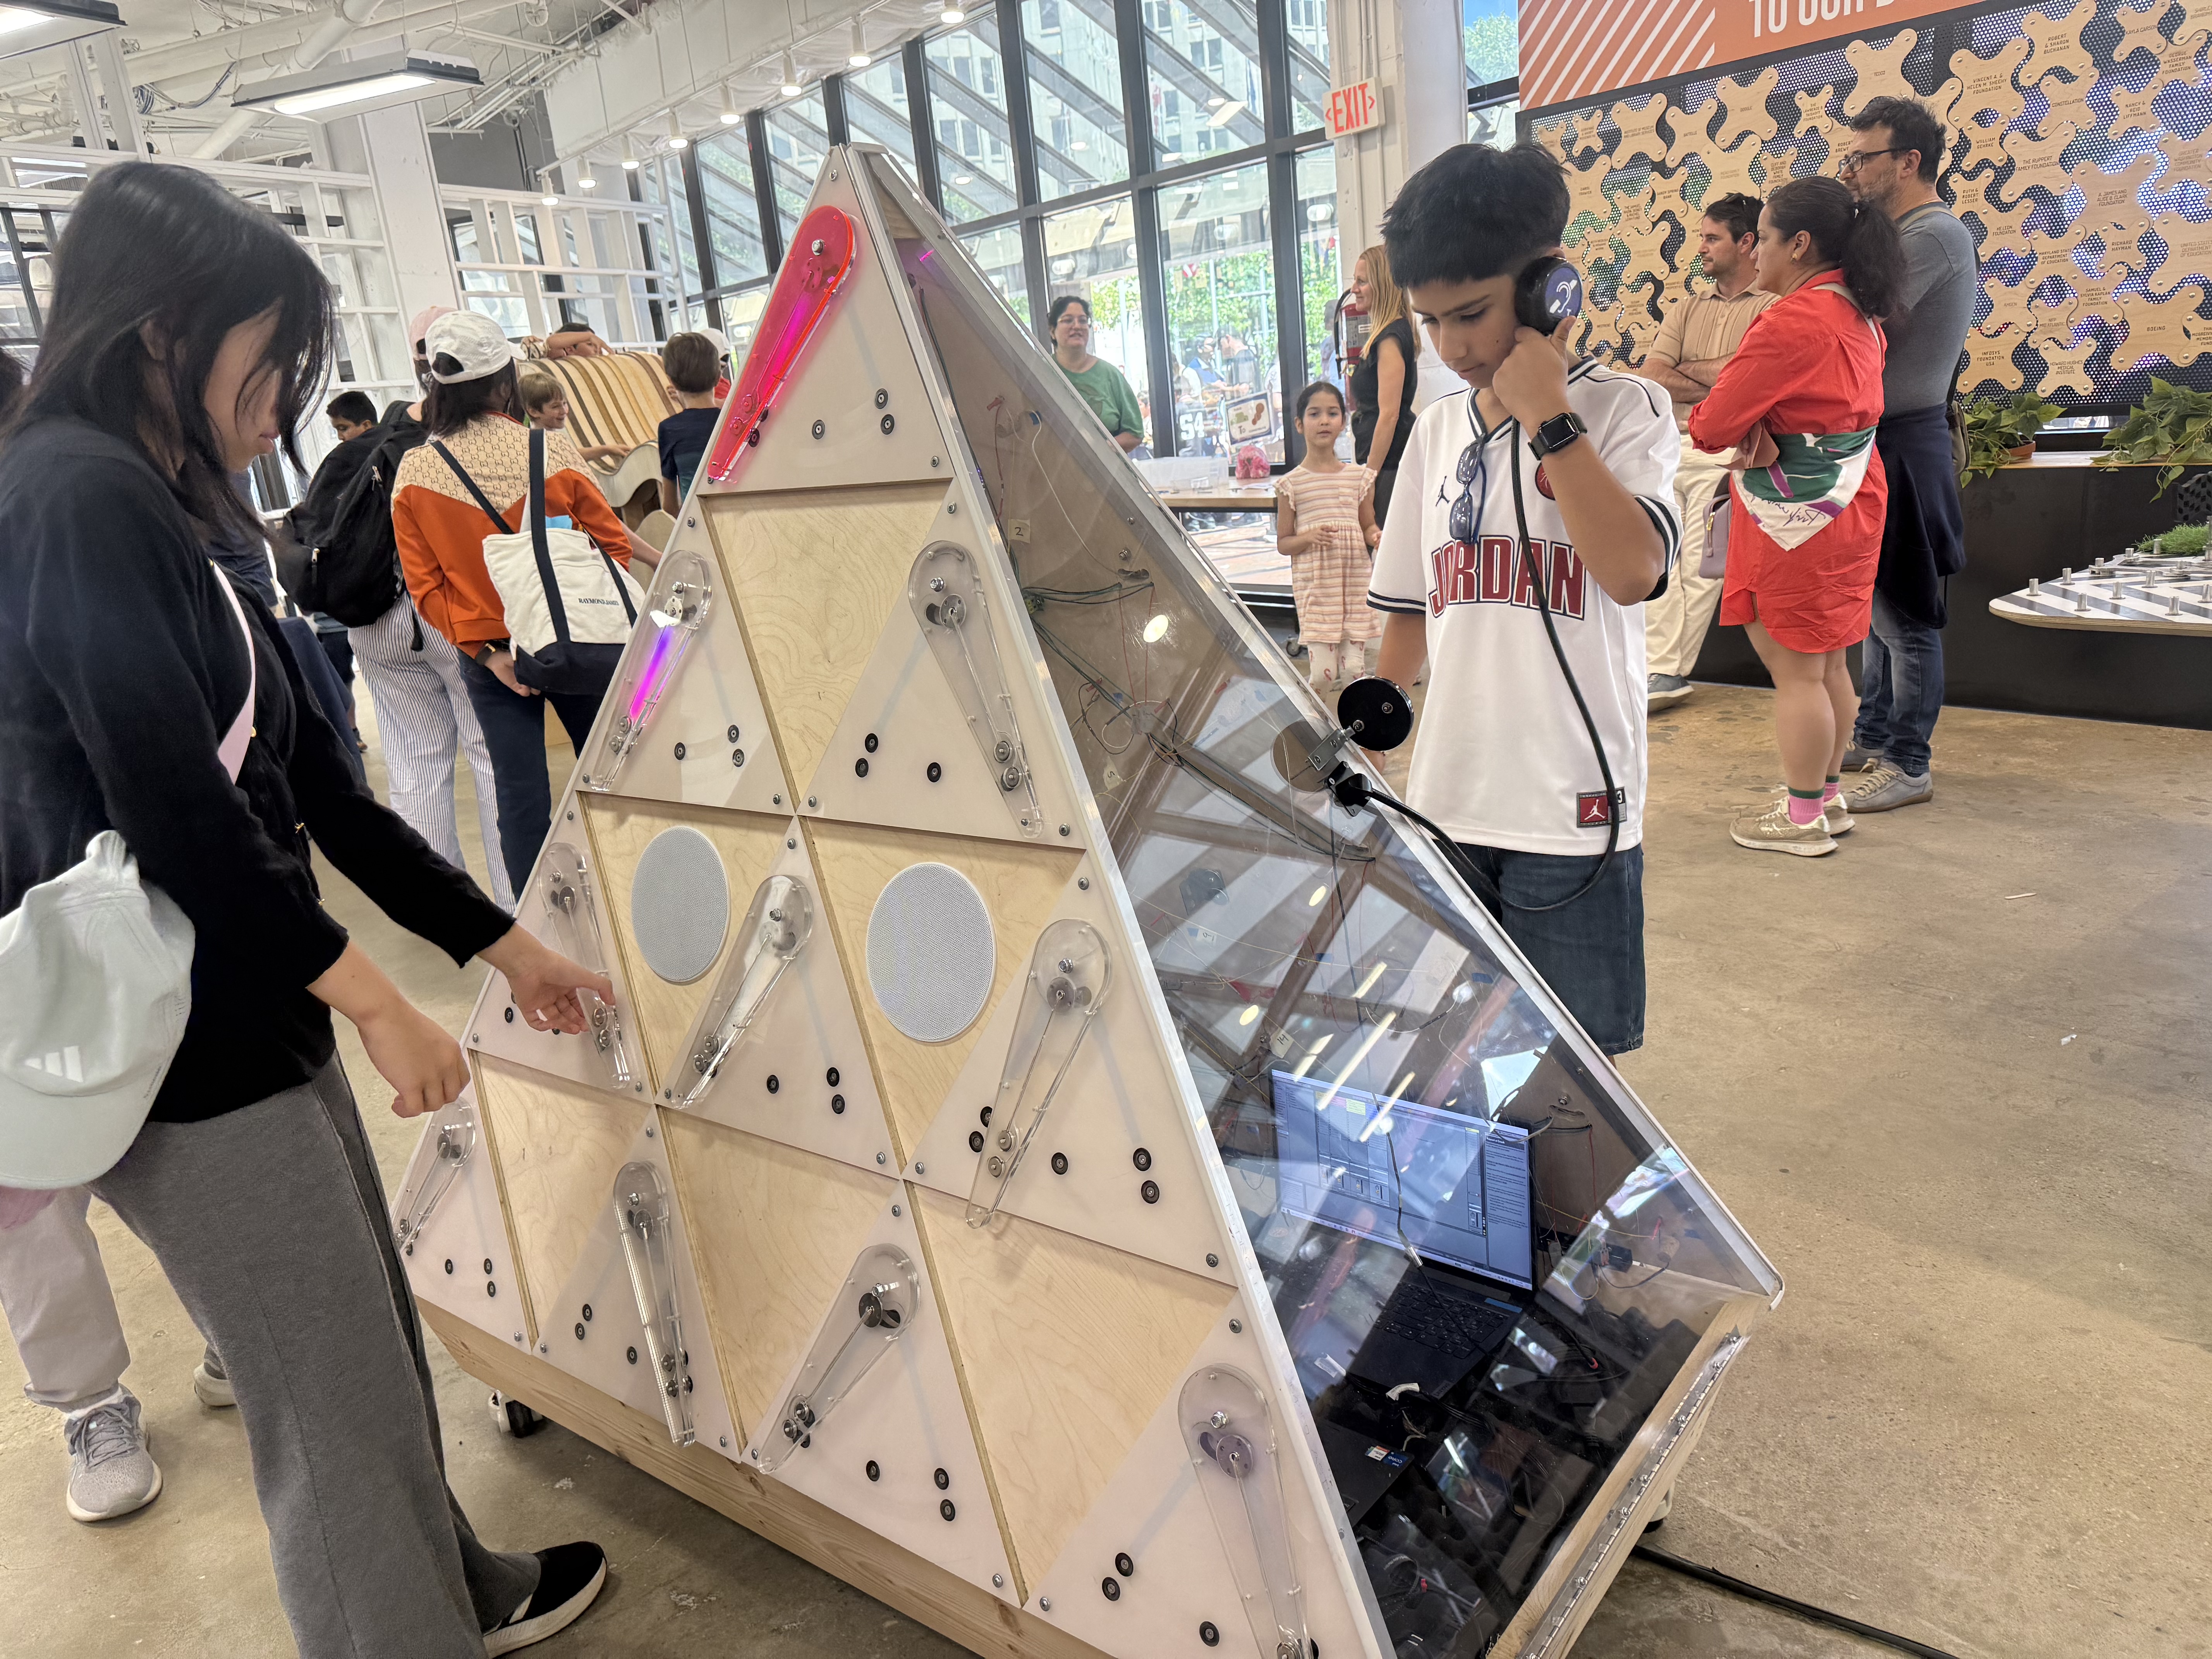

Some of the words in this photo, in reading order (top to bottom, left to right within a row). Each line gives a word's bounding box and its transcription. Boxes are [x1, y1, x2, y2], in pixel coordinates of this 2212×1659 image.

[2048, 33, 2067, 41] ROBERT
[2044, 45, 2069, 54] BUCHANAN
[2163, 55, 2192, 64] WASSERMAN
[2162, 66, 2191, 75] FOUNDATION
[1973, 85, 2002, 94] FOUNDATION
[2052, 98, 2084, 107] CONSTELLATION
[1331, 82, 1368, 133] EXIT
[2032, 160, 2059, 169] FOUNDATION
[1180, 412, 1205, 440] 54
[1015, 527, 1024, 536] 2
[1277, 1034, 1289, 1045] 14
